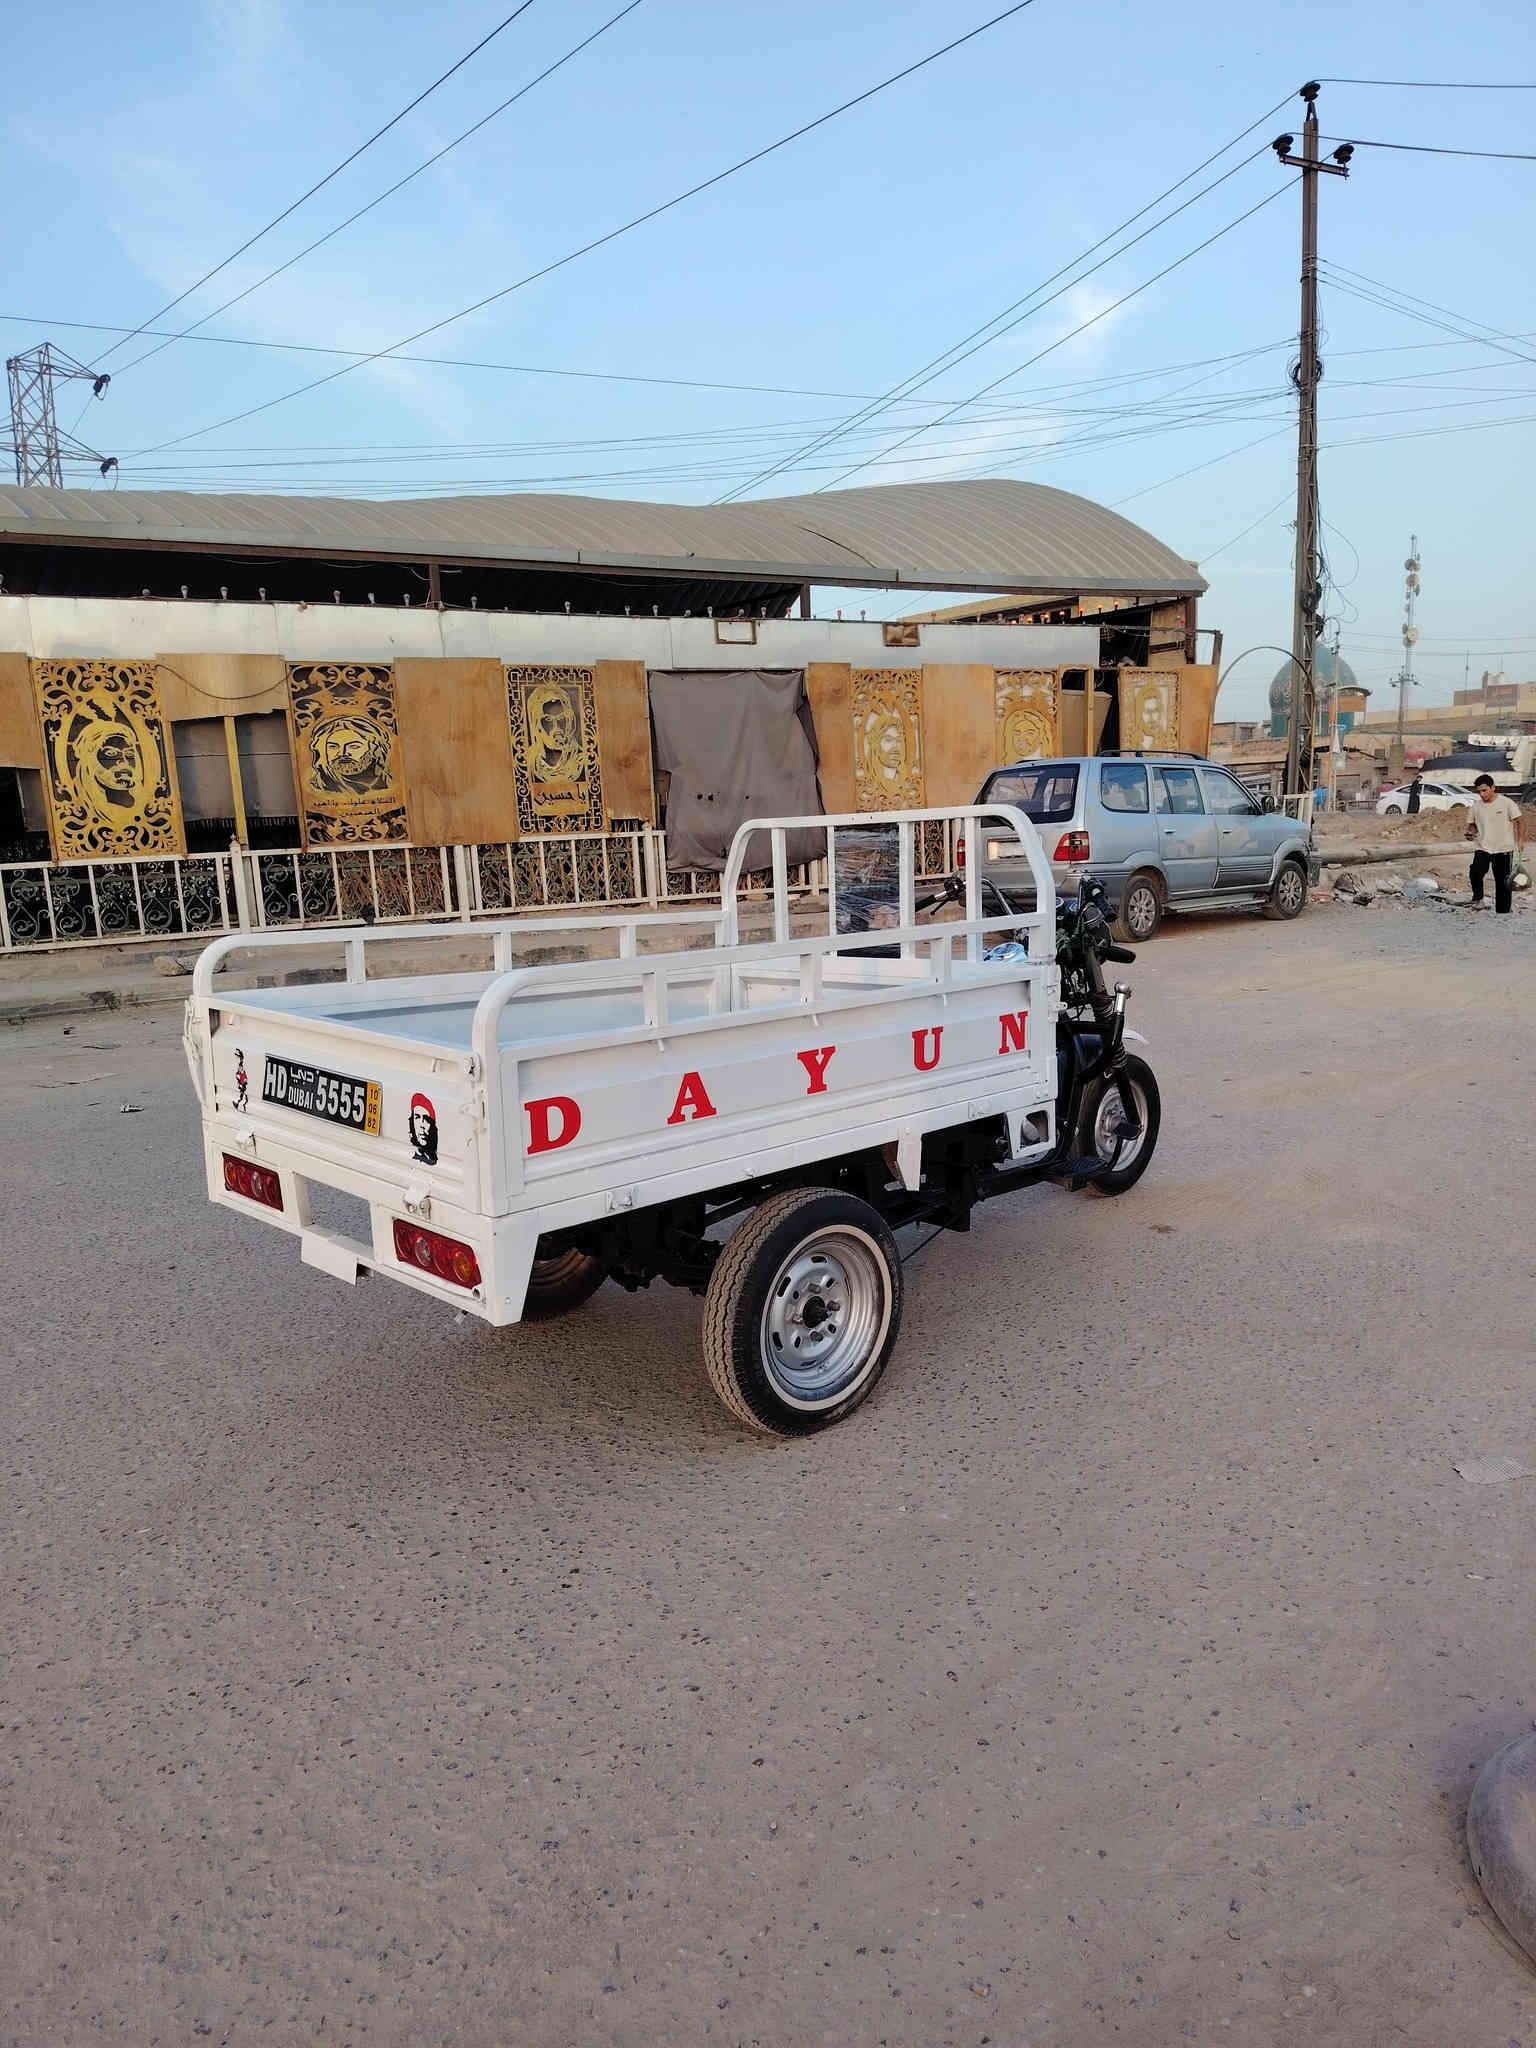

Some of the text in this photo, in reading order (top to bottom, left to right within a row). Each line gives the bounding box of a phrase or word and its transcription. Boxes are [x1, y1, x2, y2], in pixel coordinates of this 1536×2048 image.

[534, 790, 576, 806] حسين
[264, 1062, 288, 1099] HD
[288, 1086, 314, 1110] DUBAI
[316, 1076, 365, 1122] 5555
[370, 1089, 379, 1100] 10
